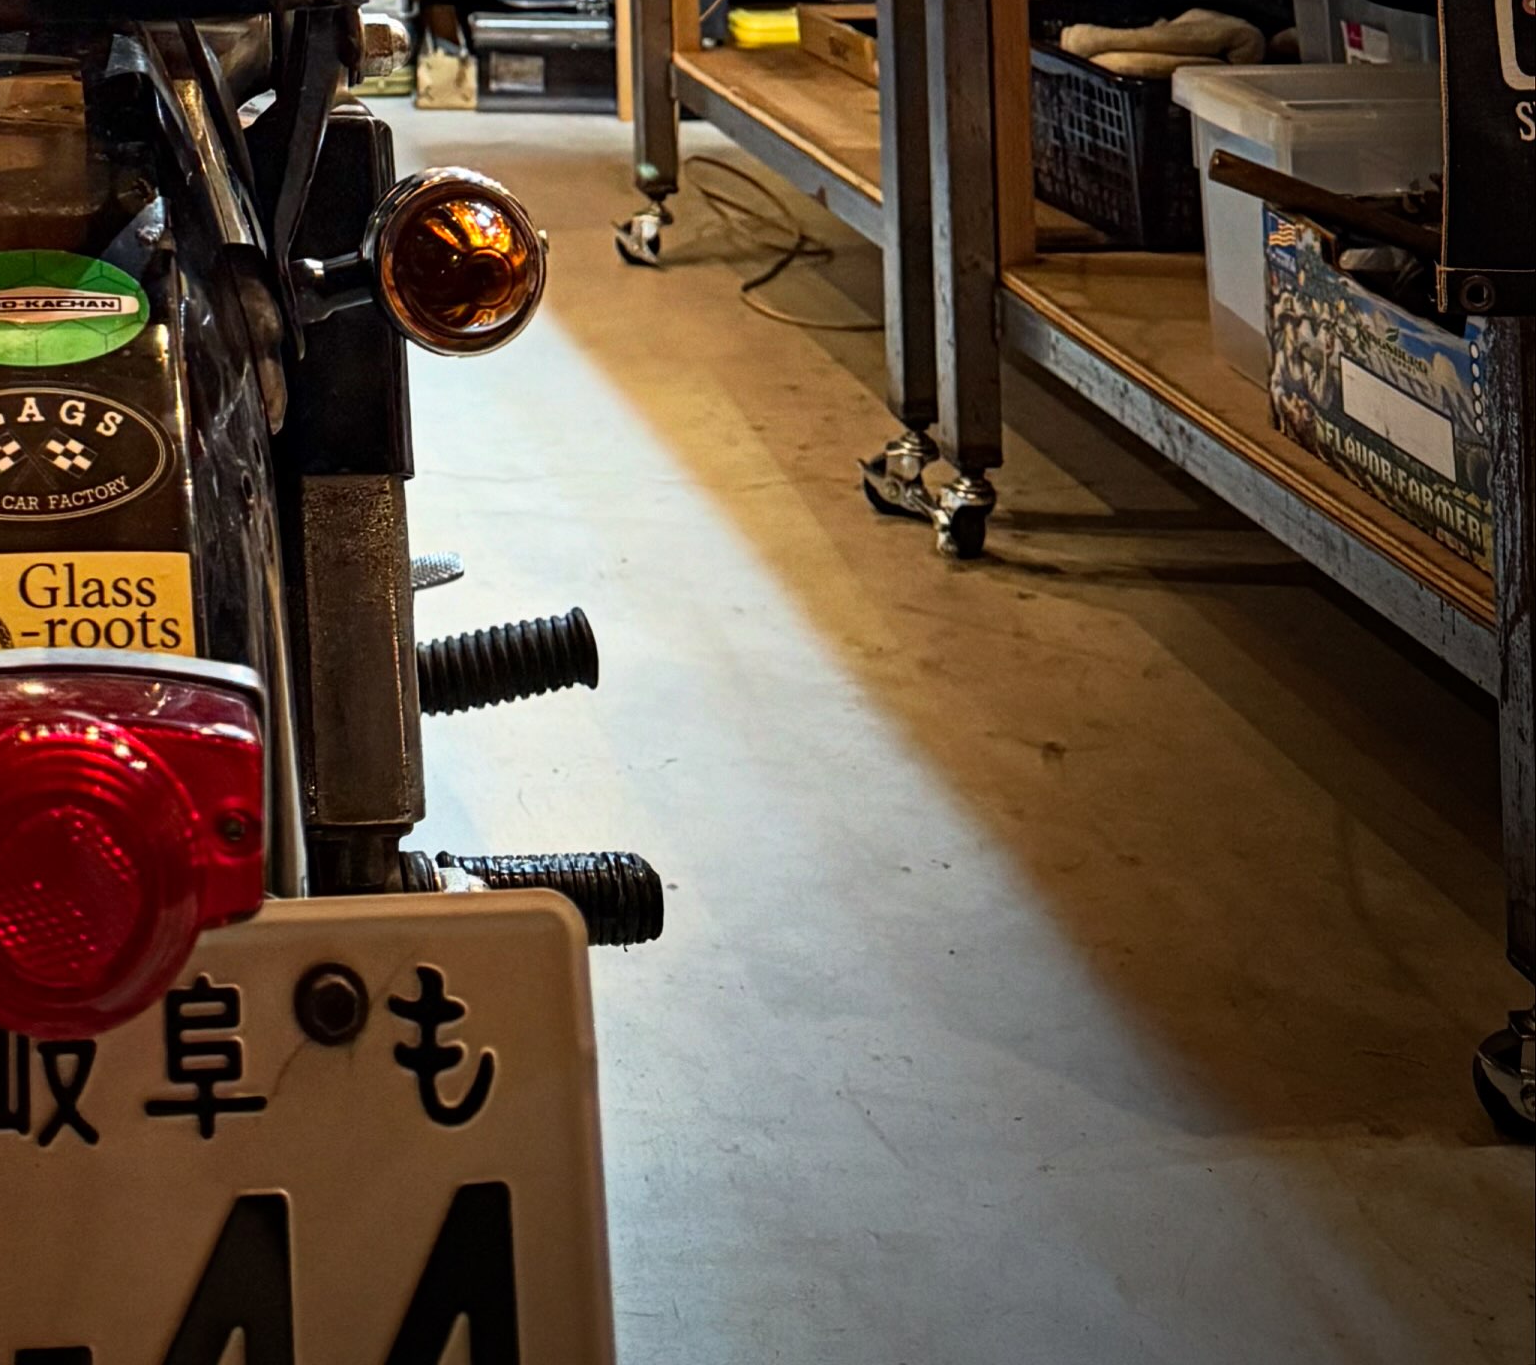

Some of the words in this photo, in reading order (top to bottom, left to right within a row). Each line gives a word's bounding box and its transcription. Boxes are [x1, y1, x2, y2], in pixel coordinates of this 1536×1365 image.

[1, 495, 40, 510] CAR
[48, 476, 130, 509] FACTORY
[1397, 467, 1484, 550] FARMER
[19, 562, 156, 608] Glass
[21, 611, 181, 648] -roots
[388, 966, 495, 1127] も
